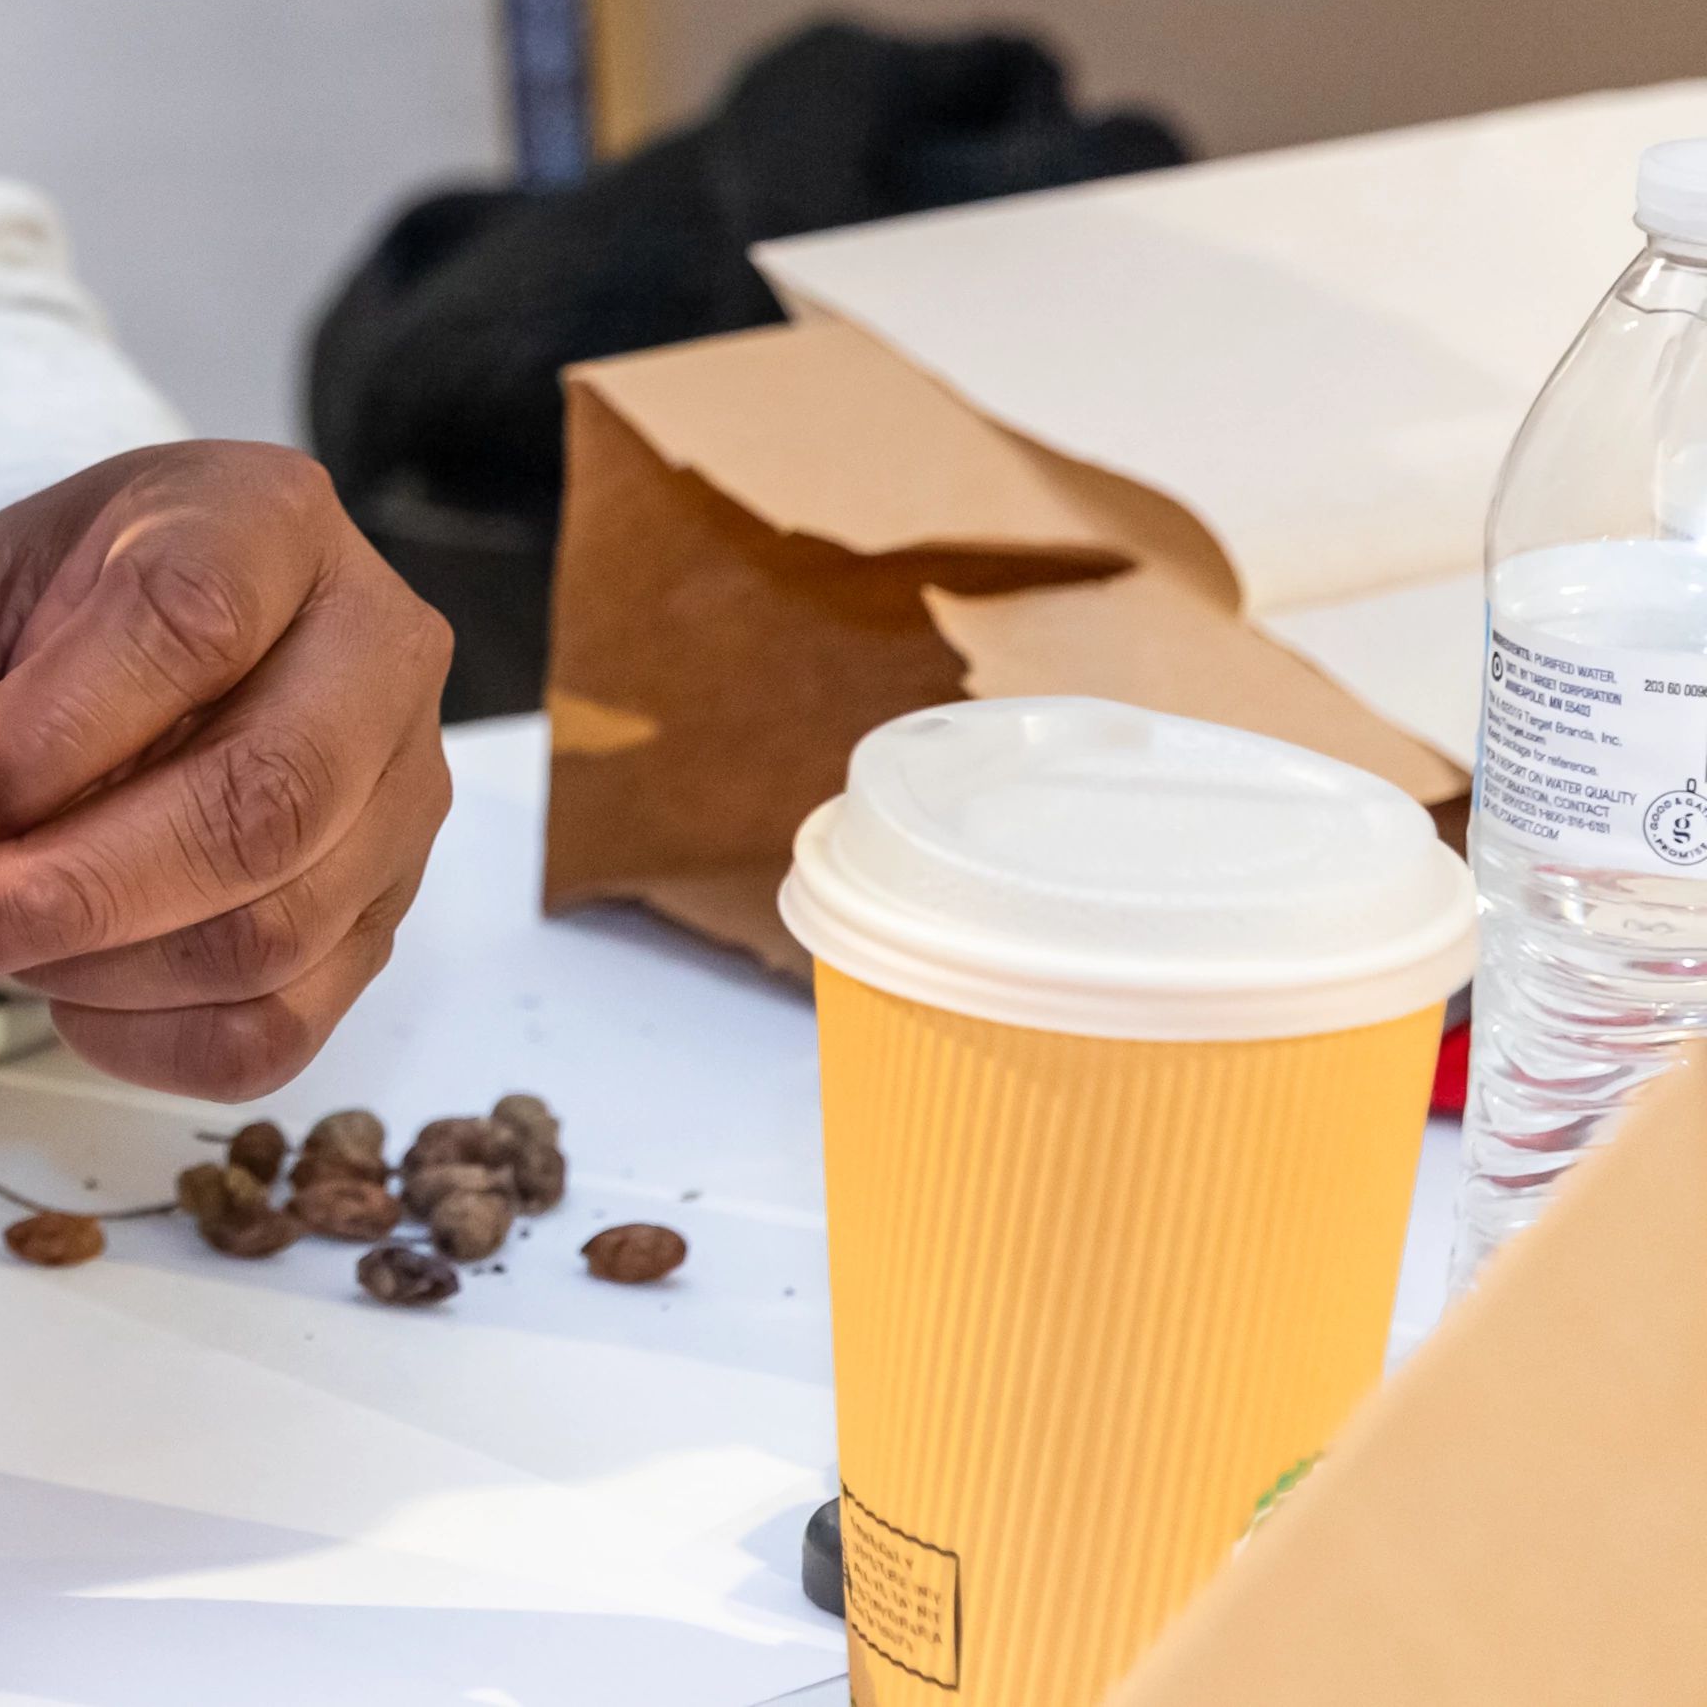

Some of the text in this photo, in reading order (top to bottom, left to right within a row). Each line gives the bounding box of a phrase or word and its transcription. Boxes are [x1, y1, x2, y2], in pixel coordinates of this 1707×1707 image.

[1577, 666, 1617, 683] WATER.
[1559, 682, 1622, 705] CORPORATION
[1644, 679, 1664, 693] 203
[1668, 682, 1681, 695] 60
[1525, 711, 1553, 730] Target
[1555, 721, 1597, 743] Brands,
[1601, 732, 1623, 747] Inc.
[1548, 755, 1599, 776] reference.
[1528, 770, 1543, 785] ON
[1545, 776, 1582, 794] WATER
[1585, 785, 1637, 806] QUALITY
[1553, 796, 1610, 818] CONTACT
